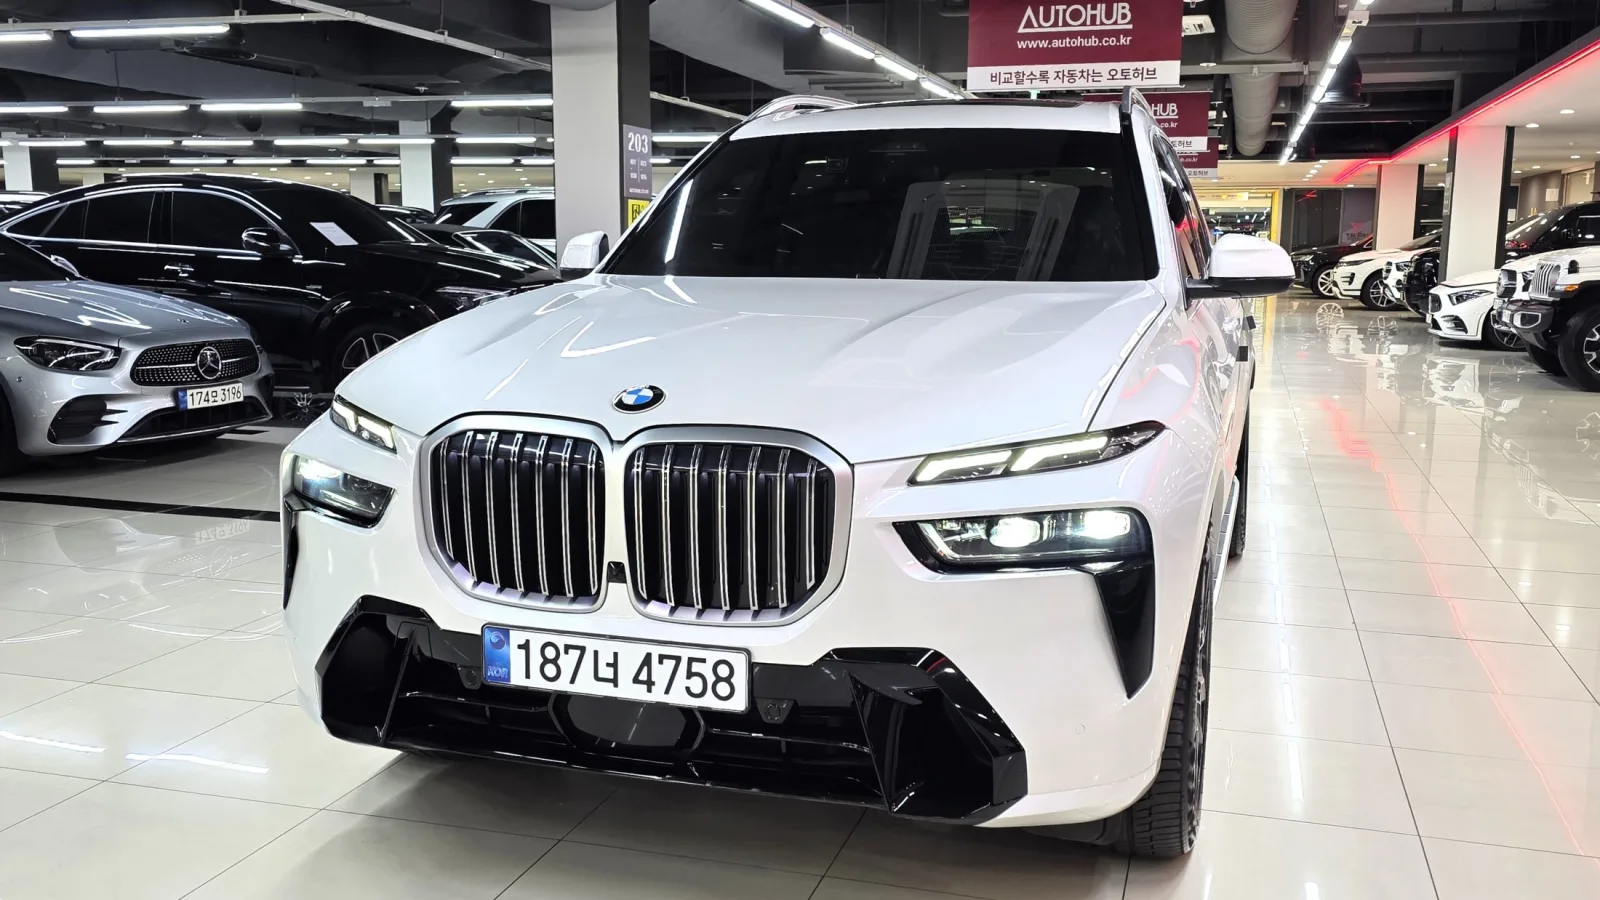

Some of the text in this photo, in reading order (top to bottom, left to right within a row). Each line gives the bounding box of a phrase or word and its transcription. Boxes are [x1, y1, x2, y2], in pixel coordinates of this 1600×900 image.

[1017, 3, 1133, 33] AUTOHUB
[1017, 35, 1132, 49] www.autohub.co.kr
[990, 67, 1158, 85] 비교할수록 자동차는 오토허브
[628, 132, 648, 153] 203
[190, 386, 241, 406] 174모 3196
[517, 639, 735, 701] 187너 4758
